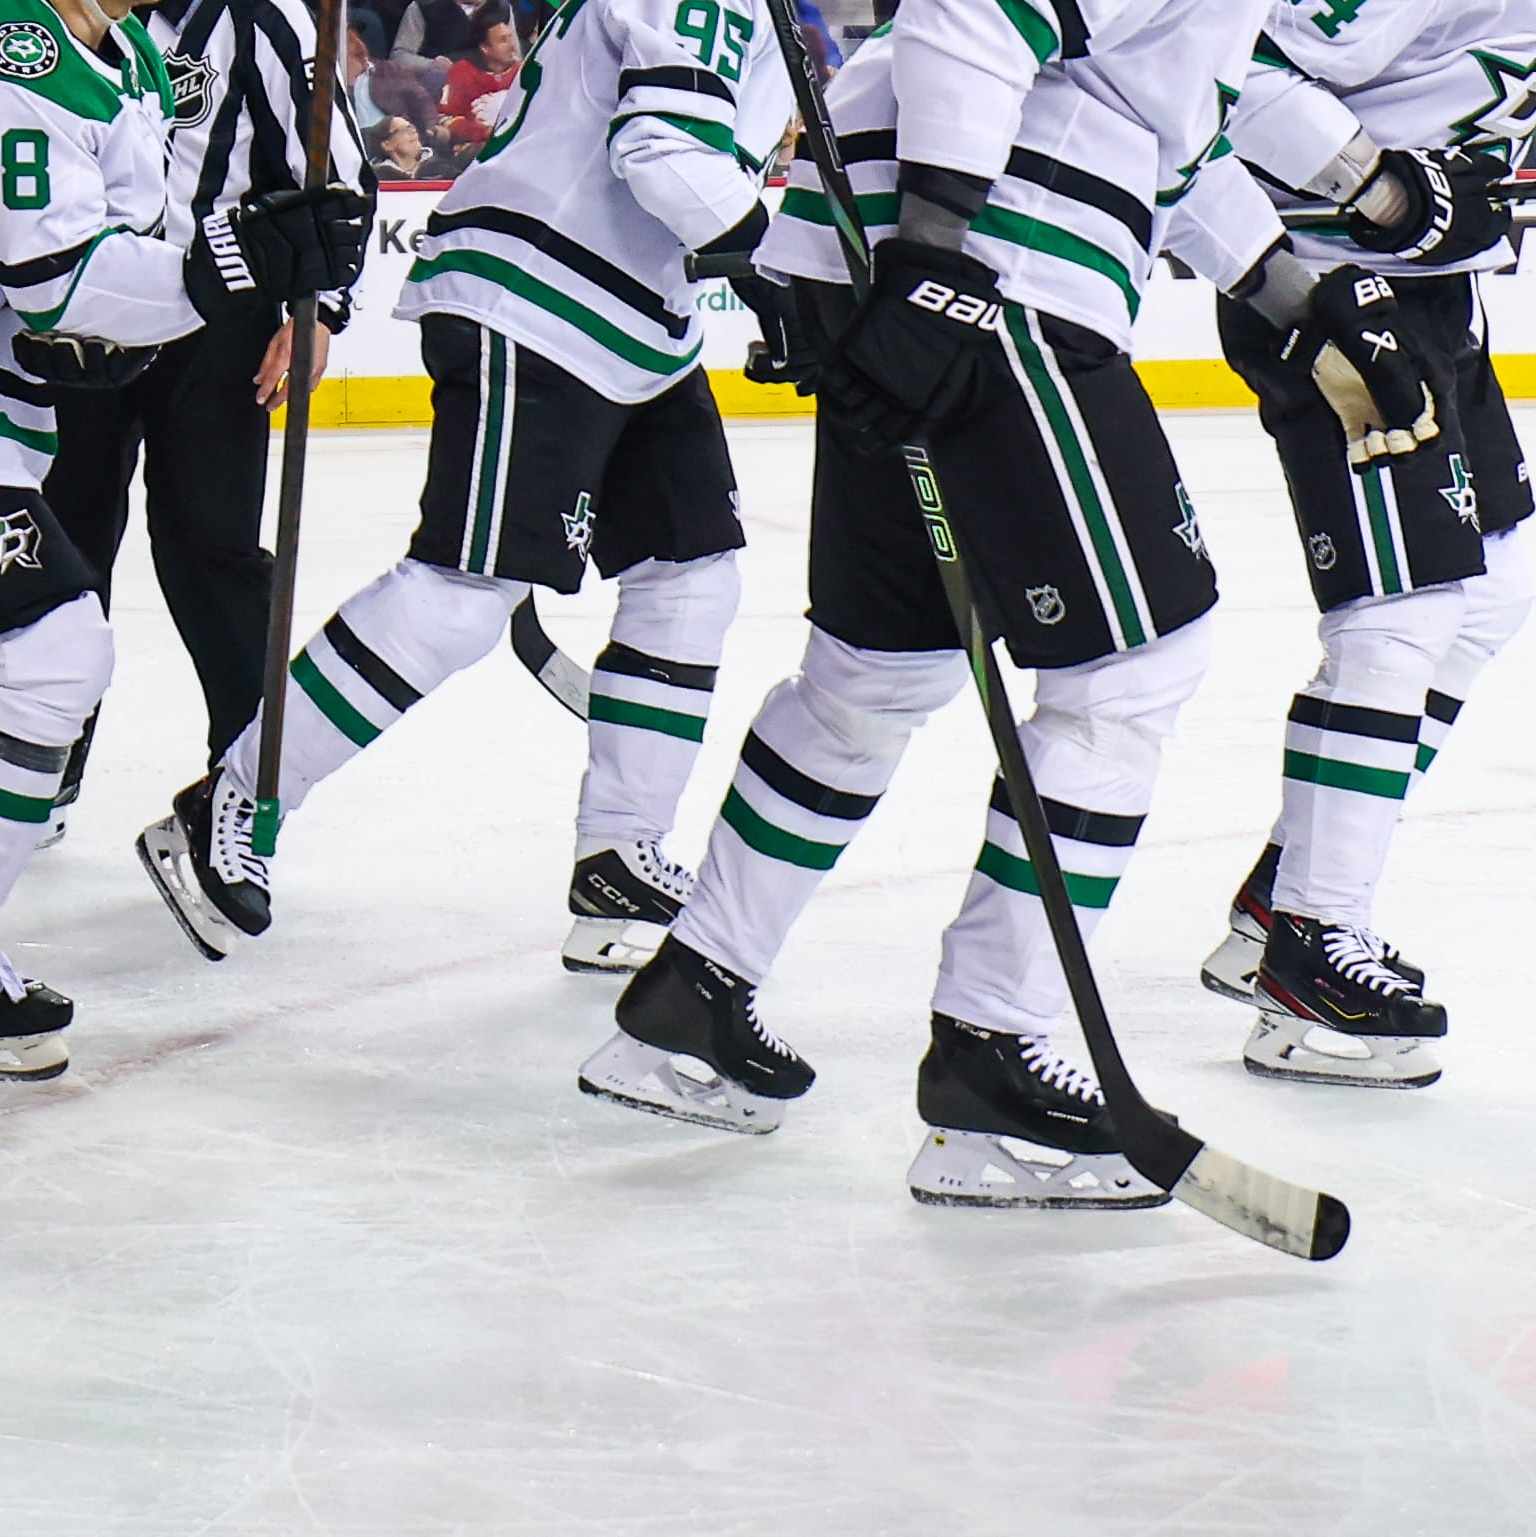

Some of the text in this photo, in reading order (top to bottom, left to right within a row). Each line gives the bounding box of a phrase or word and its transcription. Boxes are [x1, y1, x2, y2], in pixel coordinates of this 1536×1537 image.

[171, 75, 202, 98] HL
[588, 872, 641, 913] CCM
[704, 960, 736, 990] TRUE
[954, 1020, 992, 1041] TRUE
